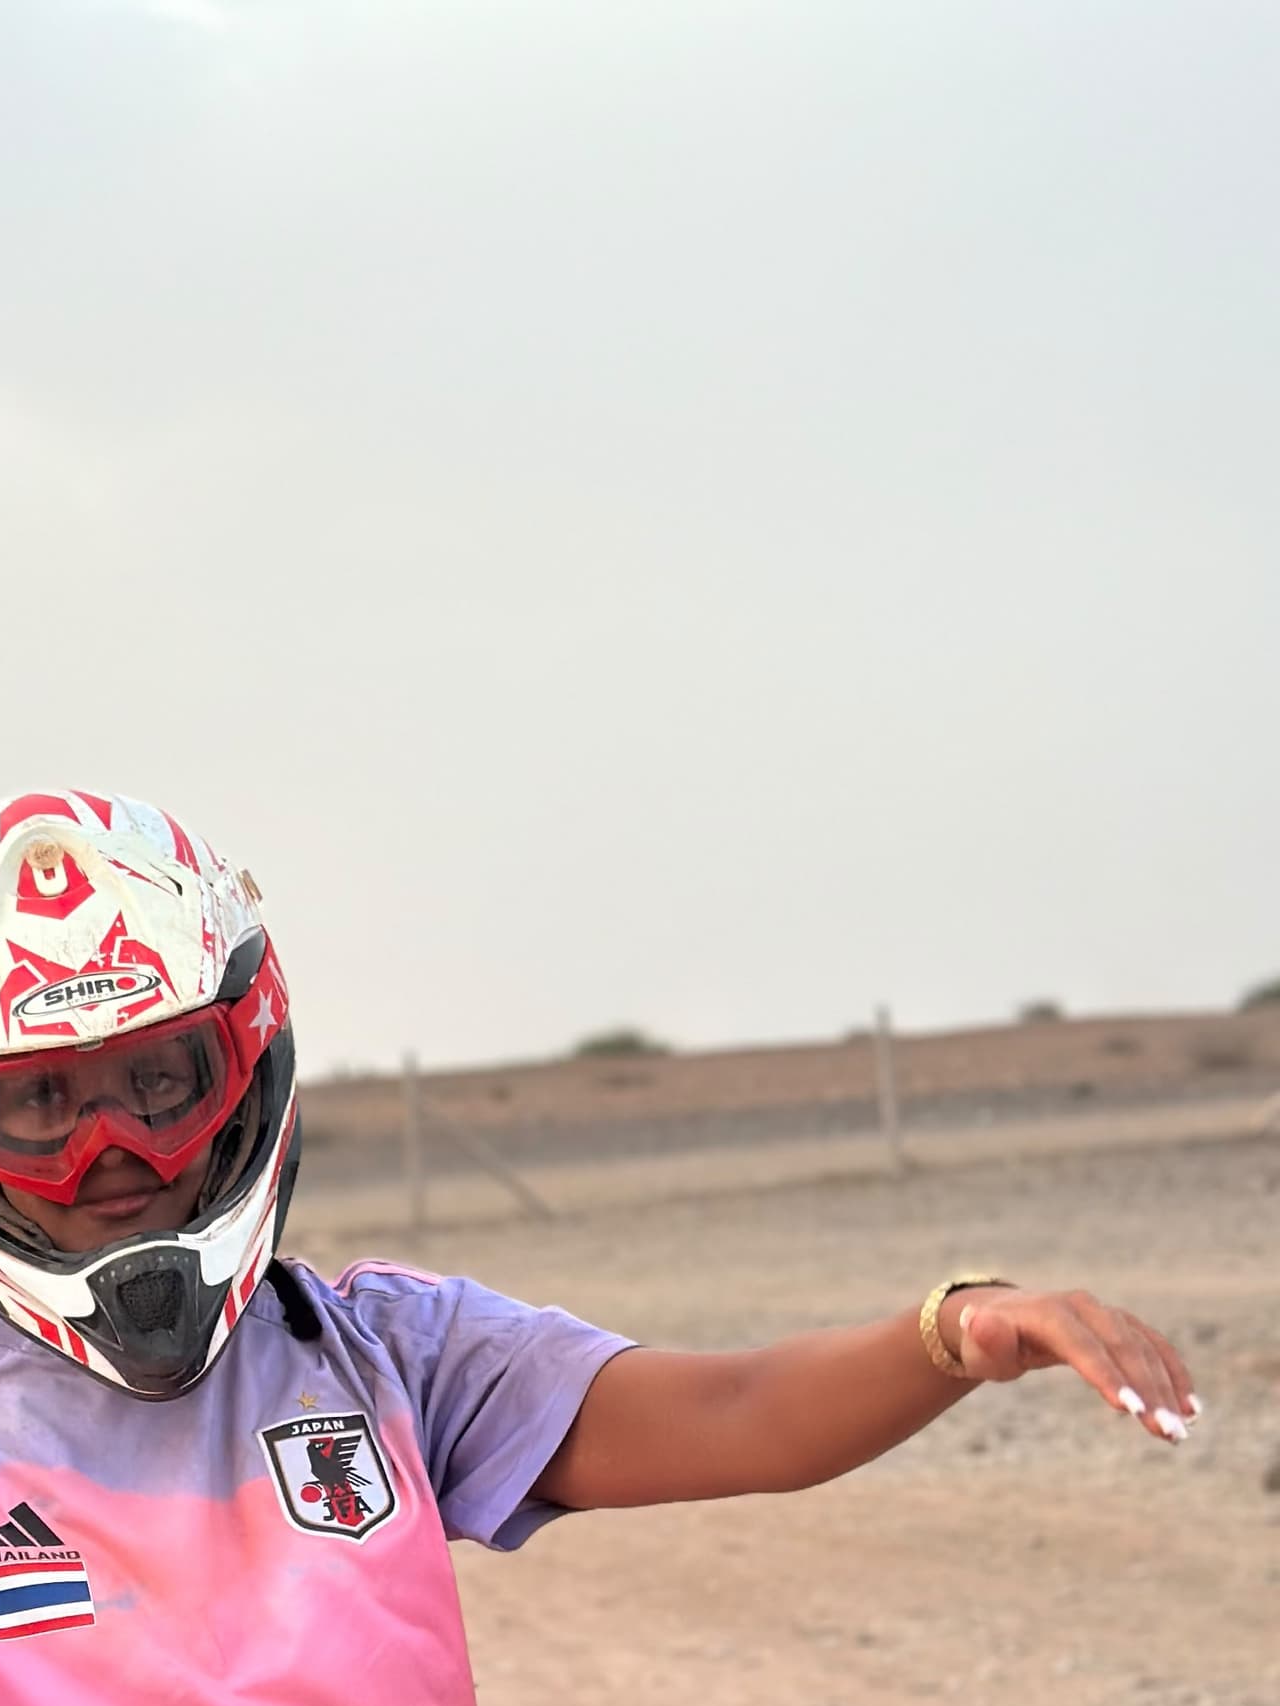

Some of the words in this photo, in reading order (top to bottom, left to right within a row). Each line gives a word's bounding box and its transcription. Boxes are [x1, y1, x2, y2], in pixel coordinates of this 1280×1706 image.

[44, 976, 137, 1007] SHIRO
[291, 1420, 345, 1435] JAPAN
[321, 1495, 375, 1522] JFA
